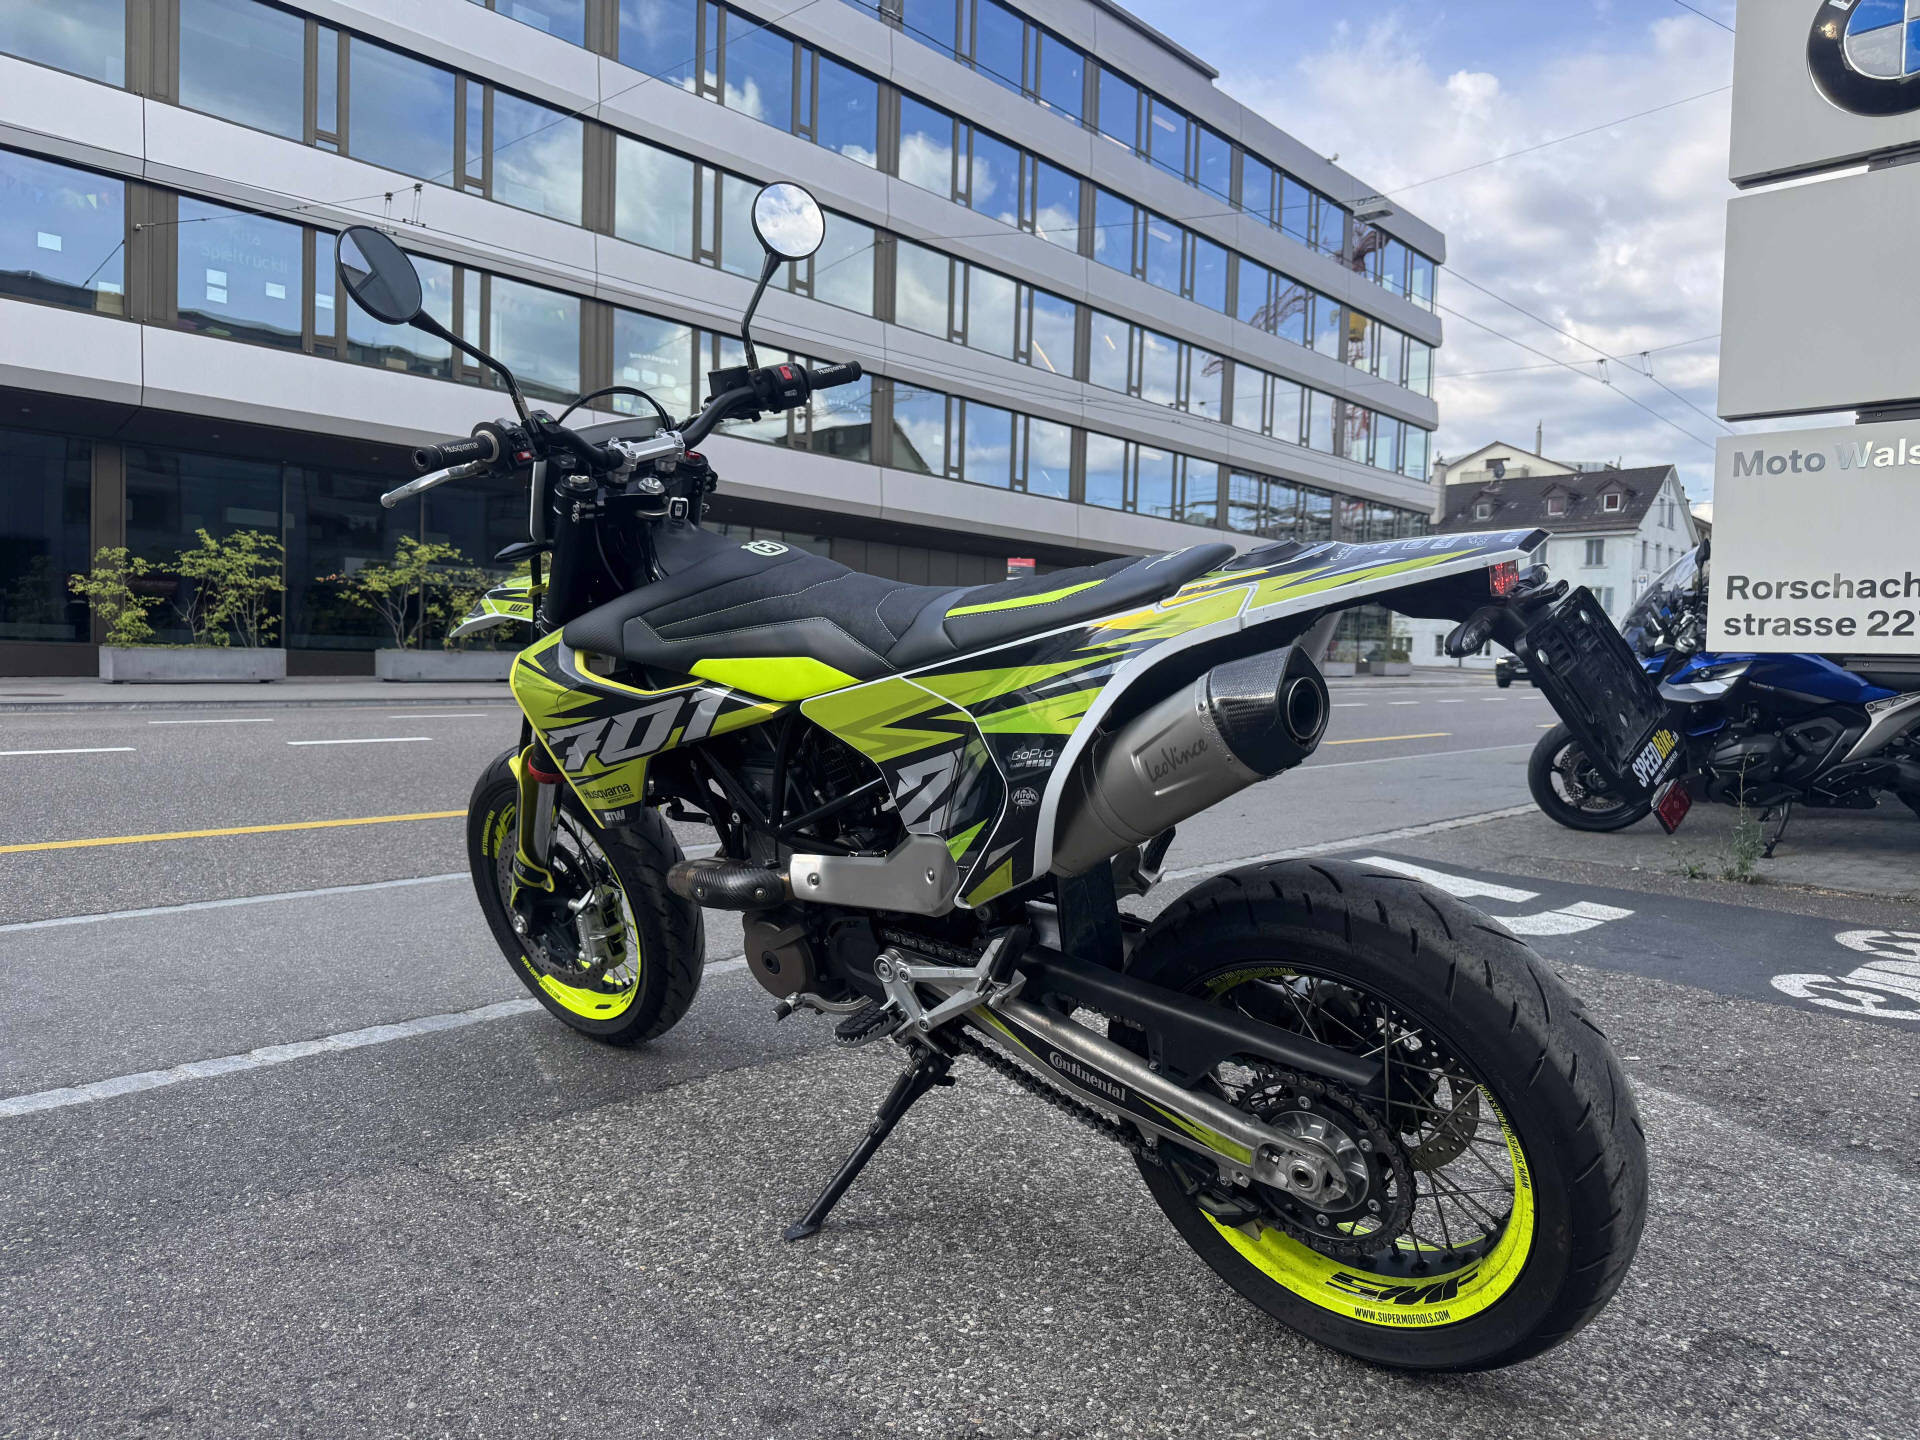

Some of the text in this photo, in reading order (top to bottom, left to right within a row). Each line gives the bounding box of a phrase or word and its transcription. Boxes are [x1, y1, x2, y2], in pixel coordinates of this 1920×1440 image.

[442, 442, 479, 453] Husqvarna
[1733, 449, 1826, 477] Moto
[1726, 571, 1920, 600] Rorschach
[1724, 610, 1920, 637] strasse 22
[547, 690, 731, 771] 701
[1011, 748, 1054, 761] GoPro
[1144, 738, 1208, 782] LeoVince
[582, 783, 631, 800] Husqvarna
[1049, 1051, 1126, 1102] Continental
[1354, 1306, 1451, 1325] WWW.SUPERMOFOOLS.COM
